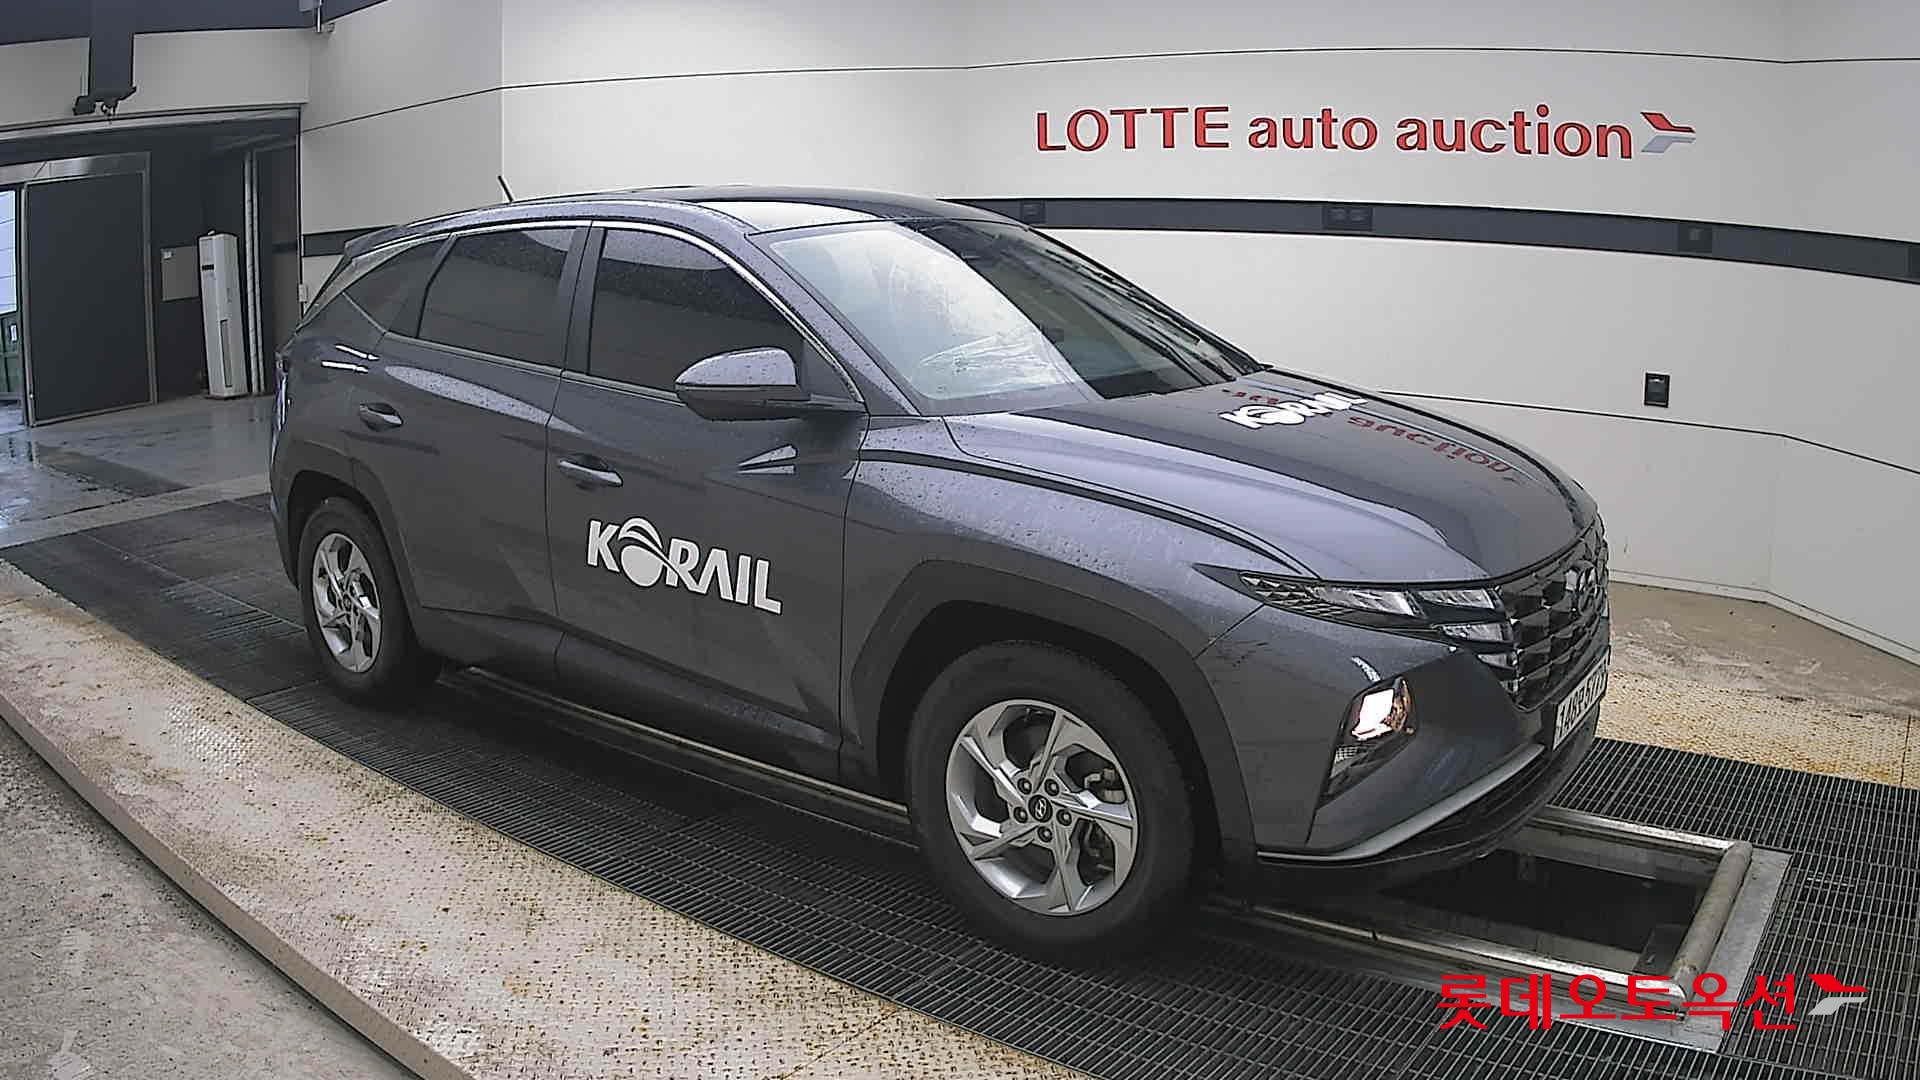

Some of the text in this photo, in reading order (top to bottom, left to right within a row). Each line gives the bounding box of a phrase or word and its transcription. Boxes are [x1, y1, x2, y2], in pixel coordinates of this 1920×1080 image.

[1036, 105, 1632, 159] LOTTE auto auction
[1218, 391, 1368, 429] KORAIL
[586, 517, 782, 614] KORAIL
